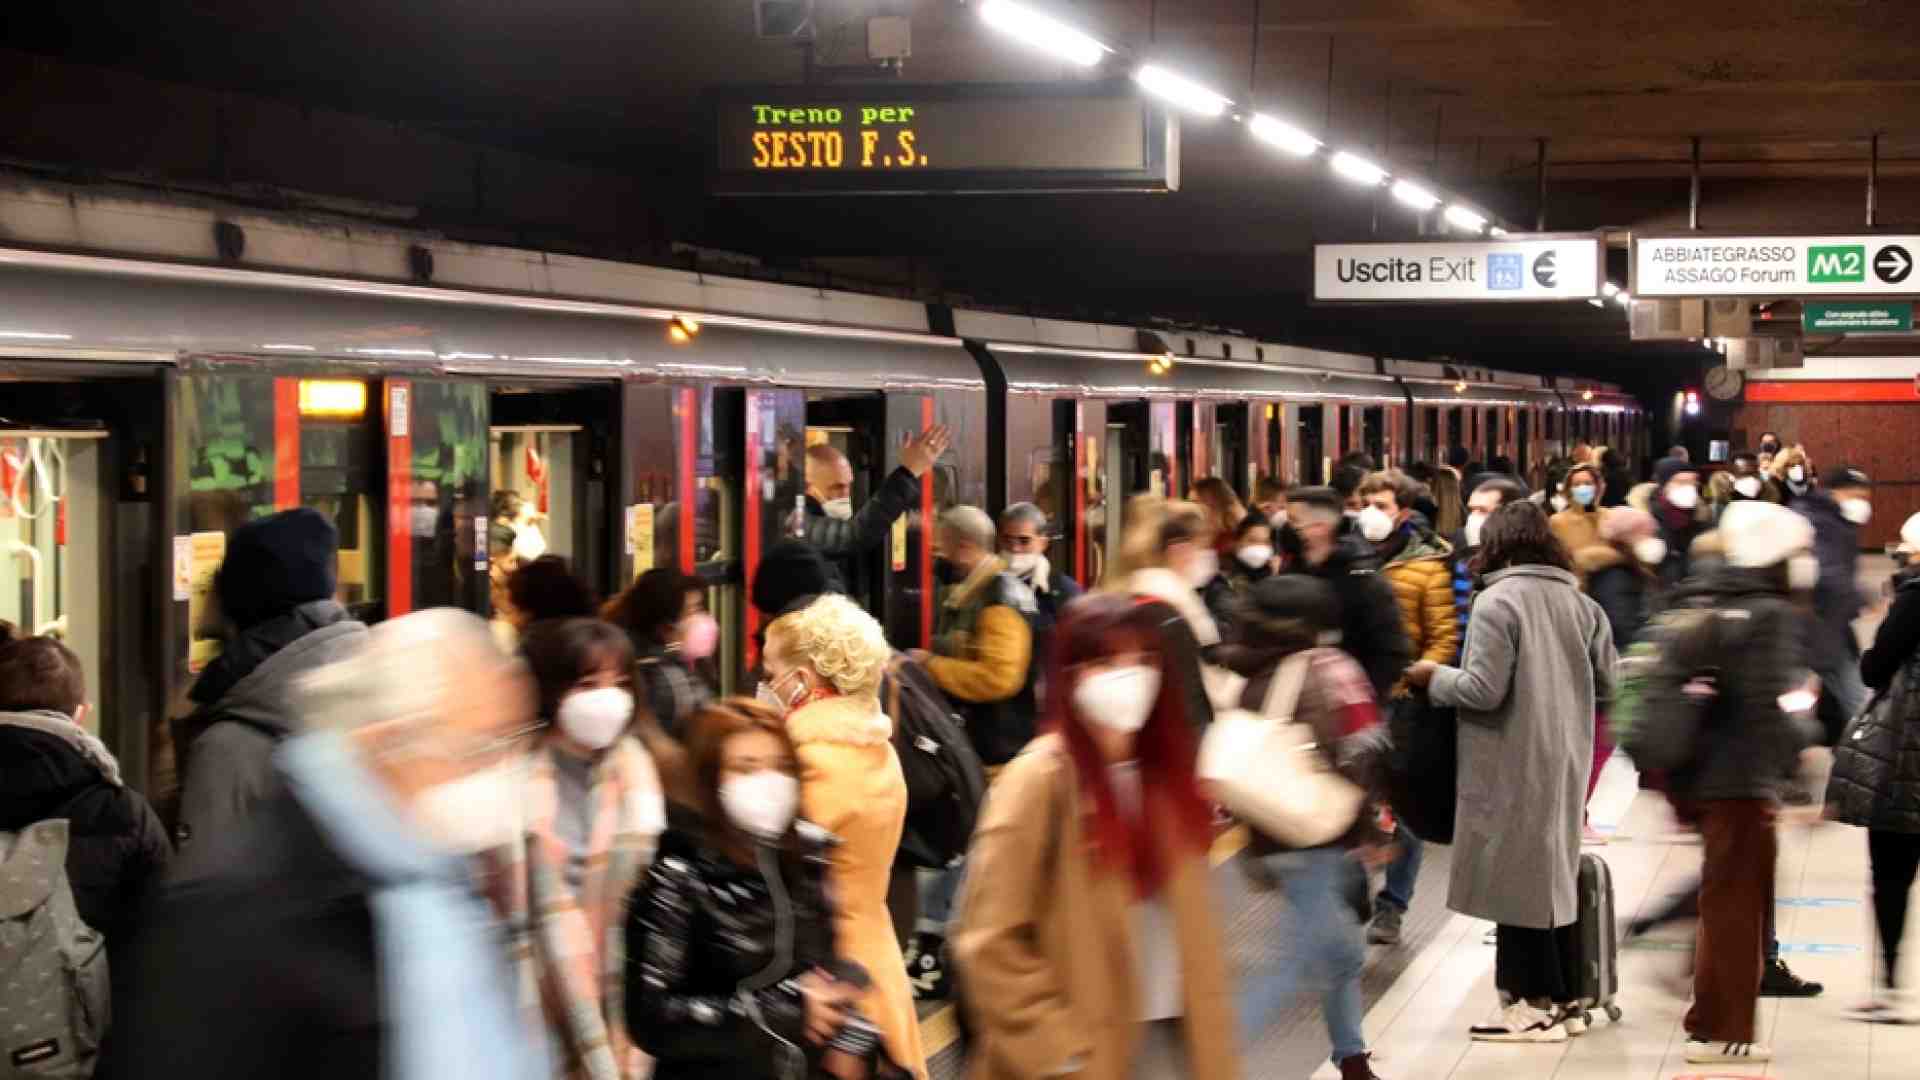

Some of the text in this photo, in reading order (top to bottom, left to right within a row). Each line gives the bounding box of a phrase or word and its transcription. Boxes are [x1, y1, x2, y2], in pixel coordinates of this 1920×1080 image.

[752, 105, 914, 125] Treno per
[752, 130, 928, 167] SESTO F.S.
[1652, 246, 1796, 262] ABBIATEGRASSO
[1811, 252, 1861, 276] M2
[1337, 257, 1476, 283] Uscita Exit
[1664, 267, 1796, 283] ASSAGO Forum
